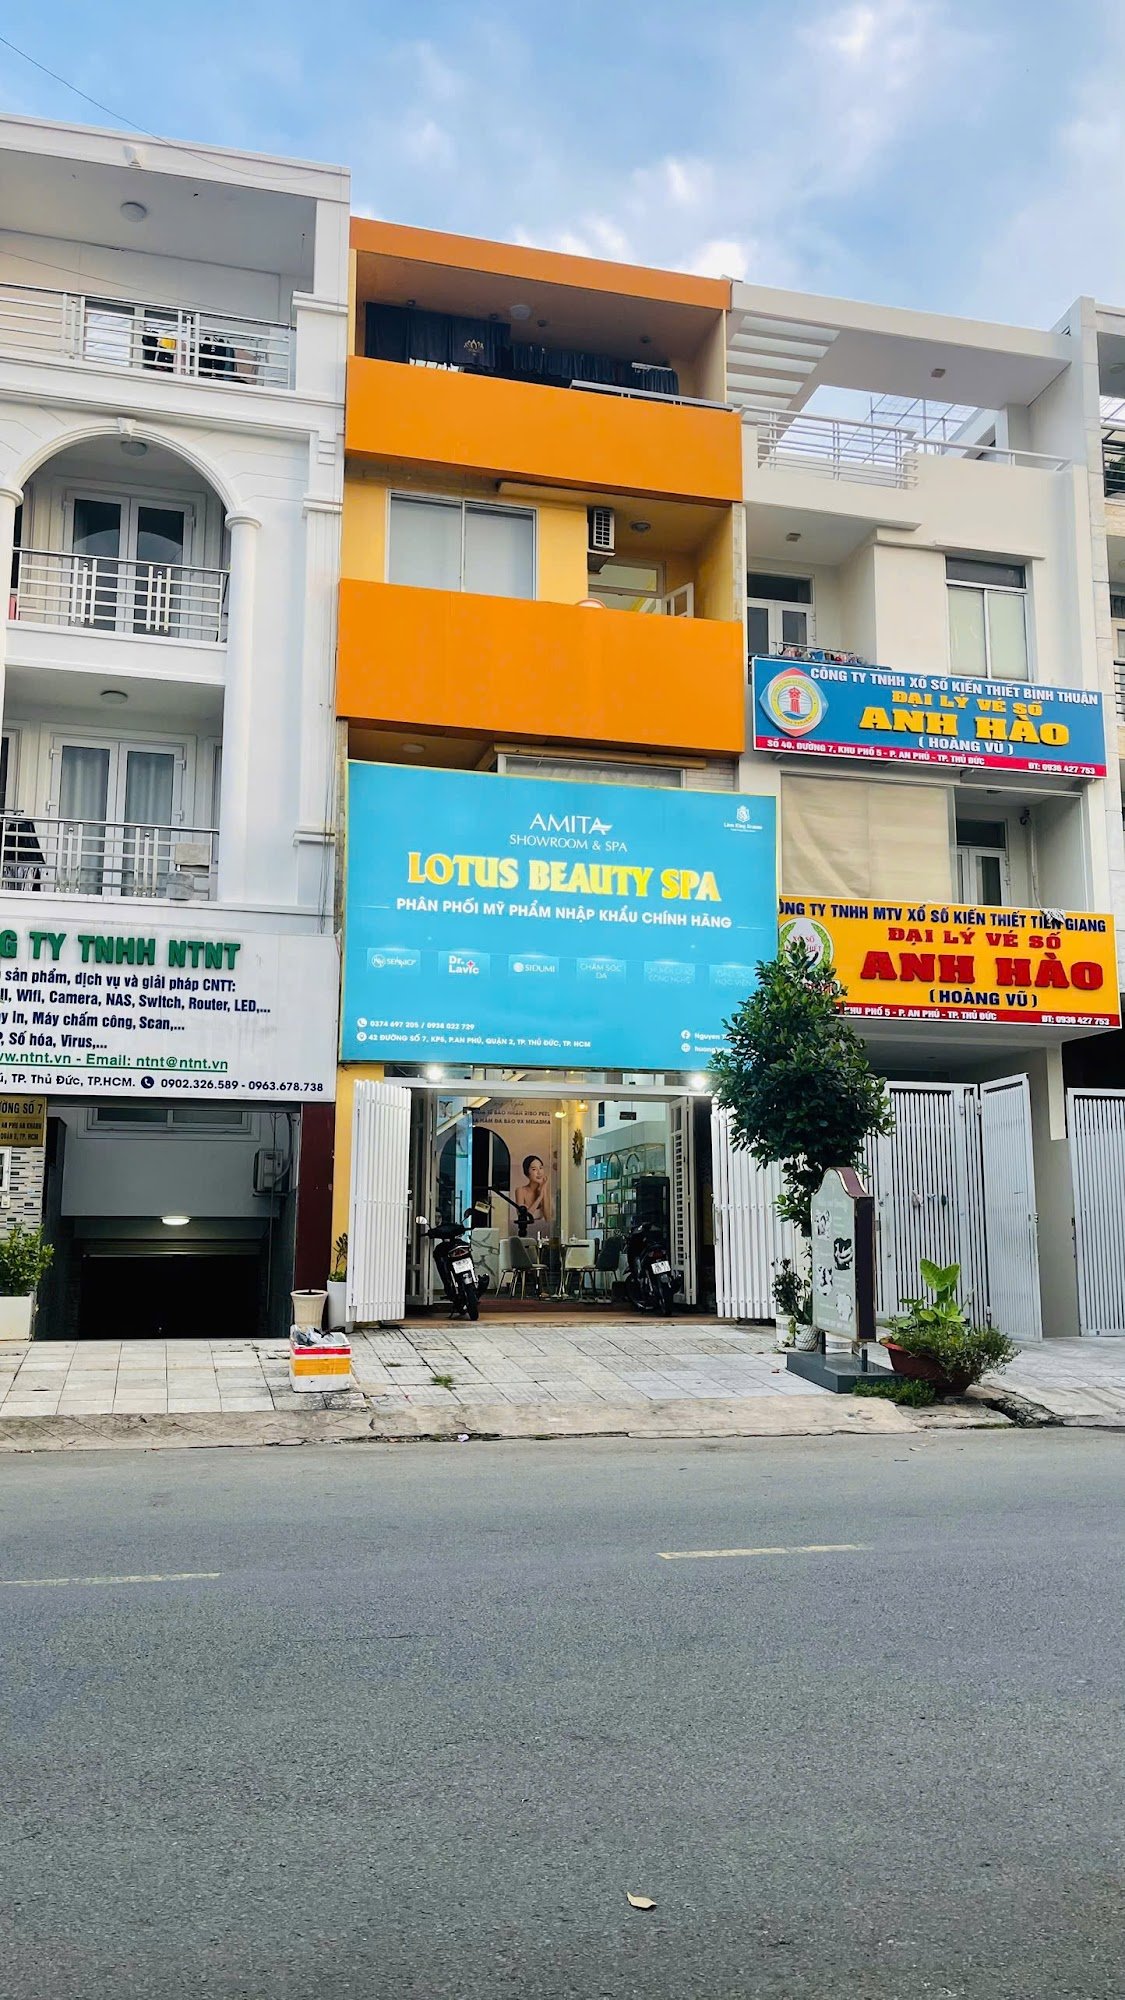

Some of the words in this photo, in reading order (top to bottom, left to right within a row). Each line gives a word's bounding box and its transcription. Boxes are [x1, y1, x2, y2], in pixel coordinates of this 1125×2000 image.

[810, 667, 848, 682] CÔNG
[851, 671, 867, 684] TY
[870, 673, 906, 687] TNHH
[909, 674, 928, 689] XỔ
[930, 676, 949, 691] SỐ
[952, 680, 982, 695] KIẾN
[985, 681, 1021, 698] THIẾT
[1023, 686, 1054, 701] BÌNH
[1057, 690, 1099, 707] THUẬN
[892, 690, 933, 708] ĐẠI
[940, 694, 969, 709] LÝ
[976, 697, 1006, 713] VÉ
[1012, 700, 1043, 717] SỐ
[859, 706, 959, 737] ANH
[974, 715, 1070, 746] HÀO
[767, 738, 779, 748] SỐ
[838, 746, 855, 754] KHU
[857, 746, 875, 756] PHỐ
[889, 750, 897, 758] P.
[899, 751, 911, 759] AN
[913, 751, 930, 761] PHÚ
[937, 755, 949, 763] TP.
[929, 737, 981, 753] HOÀNG
[985, 741, 1005, 754] VŨ
[1063, 765, 1079, 773] 427
[1081, 766, 1096, 775] 753
[529, 812, 613, 835] AMITA
[509, 834, 588, 850] SHOWROOM
[592, 840, 601, 851] &
[605, 840, 628, 852] SPA
[408, 851, 519, 889] LOTUS
[528, 859, 654, 898] BEAUTY
[660, 868, 722, 902] SPA
[397, 896, 438, 912] PHÂN
[443, 897, 478, 915] PHỐI
[483, 901, 505, 916] MỸ
[509, 900, 551, 918] PHẨM
[555, 905, 595, 925] NHẬP
[600, 904, 638, 924] KHẨU
[642, 911, 687, 927] CHÍNH
[691, 912, 732, 929] HÃNG
[809, 903, 826, 917] TY
[831, 905, 868, 919] TNHH
[873, 907, 903, 921] MTV
[907, 904, 926, 922] XỔ
[930, 906, 949, 923] SỐ
[954, 908, 986, 926] KIẾN
[990, 911, 1027, 928] THIẾT
[1065, 917, 1106, 932] GIANG
[888, 927, 933, 946] ĐẠI
[943, 927, 975, 945] LÝ
[986, 930, 1018, 948] VÉ
[1029, 931, 1061, 949] SỐ
[29, 931, 67, 961] TY
[78, 934, 156, 966] TNHH
[168, 939, 241, 970] NTNT
[449, 955, 465, 965] Dr.
[525, 964, 556, 974] SIDUMI
[860, 951, 976, 984] ANH
[995, 952, 1104, 990] HÀO
[5, 967, 28, 982] sản
[31, 968, 71, 985] phẩm,
[75, 972, 102, 988] dịch
[106, 976, 121, 990] vụ
[124, 975, 138, 988] và
[169, 977, 199, 992] pháp
[203, 978, 236, 993] CNTT:
[50, 991, 102, 1007] Camera,
[106, 993, 135, 1009] NAS,
[188, 997, 231, 1013] Router,
[940, 987, 1000, 1005] HOÀNG
[1006, 991, 1028, 1006] VŨ
[32, 1011, 60, 1027] Máy
[63, 1011, 98, 1027] chấm
[102, 1014, 136, 1030] công,
[865, 1006, 883, 1016] PHỐ
[884, 1008, 890, 1016] 5
[898, 1009, 906, 1017] P.
[922, 1008, 940, 1018] PHÚ
[947, 1011, 959, 1019] TP.
[1077, 1017, 1093, 1025] 427
[9, 1031, 27, 1046] Số
[29, 1033, 57, 1049] hóa,
[409, 1033, 421, 1042] SỐ
[486, 1037, 507, 1046] QUẬN
[86, 1053, 132, 1067] Email:
[136, 1056, 228, 1071] ntnt@ntnt.vn
[12, 1073, 27, 1084] TP.
[31, 1073, 52, 1084] Thủ
[56, 1074, 84, 1087] Đức,
[88, 1076, 136, 1088] TP.HCM.
[160, 1078, 239, 1090] 0902.326.589
[248, 1080, 324, 1092] 0963.678.738
[23, 1100, 36, 1114] SỐ
[38, 1103, 43, 1114] 7
